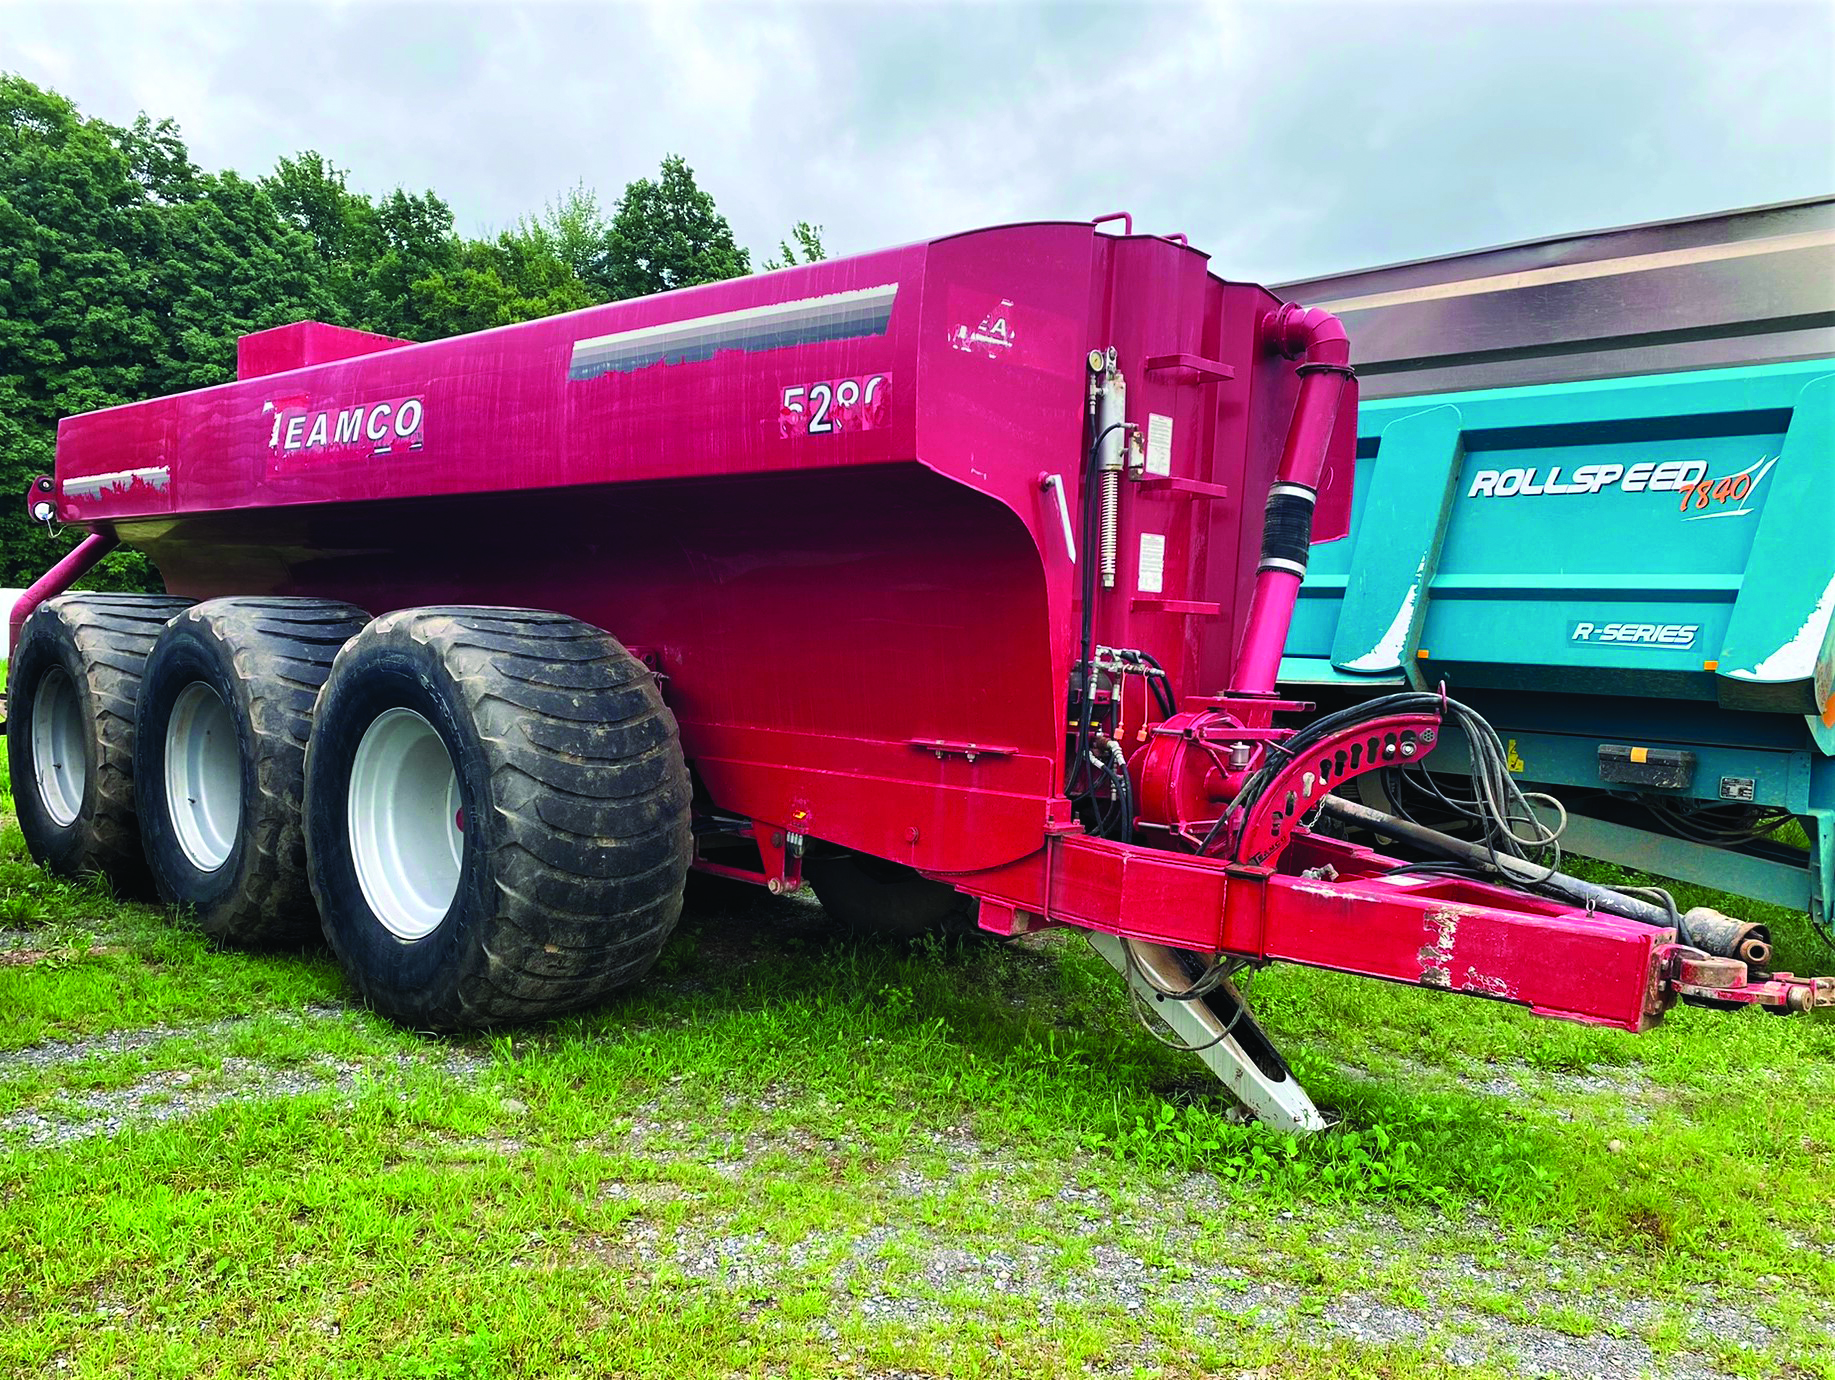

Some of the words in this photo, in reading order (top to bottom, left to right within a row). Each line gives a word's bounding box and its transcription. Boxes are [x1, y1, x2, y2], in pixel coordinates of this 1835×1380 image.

[1467, 459, 1708, 498] ROLLSPEED
[1678, 473, 1751, 512] 7840
[1571, 622, 1699, 643] R-SERIES
